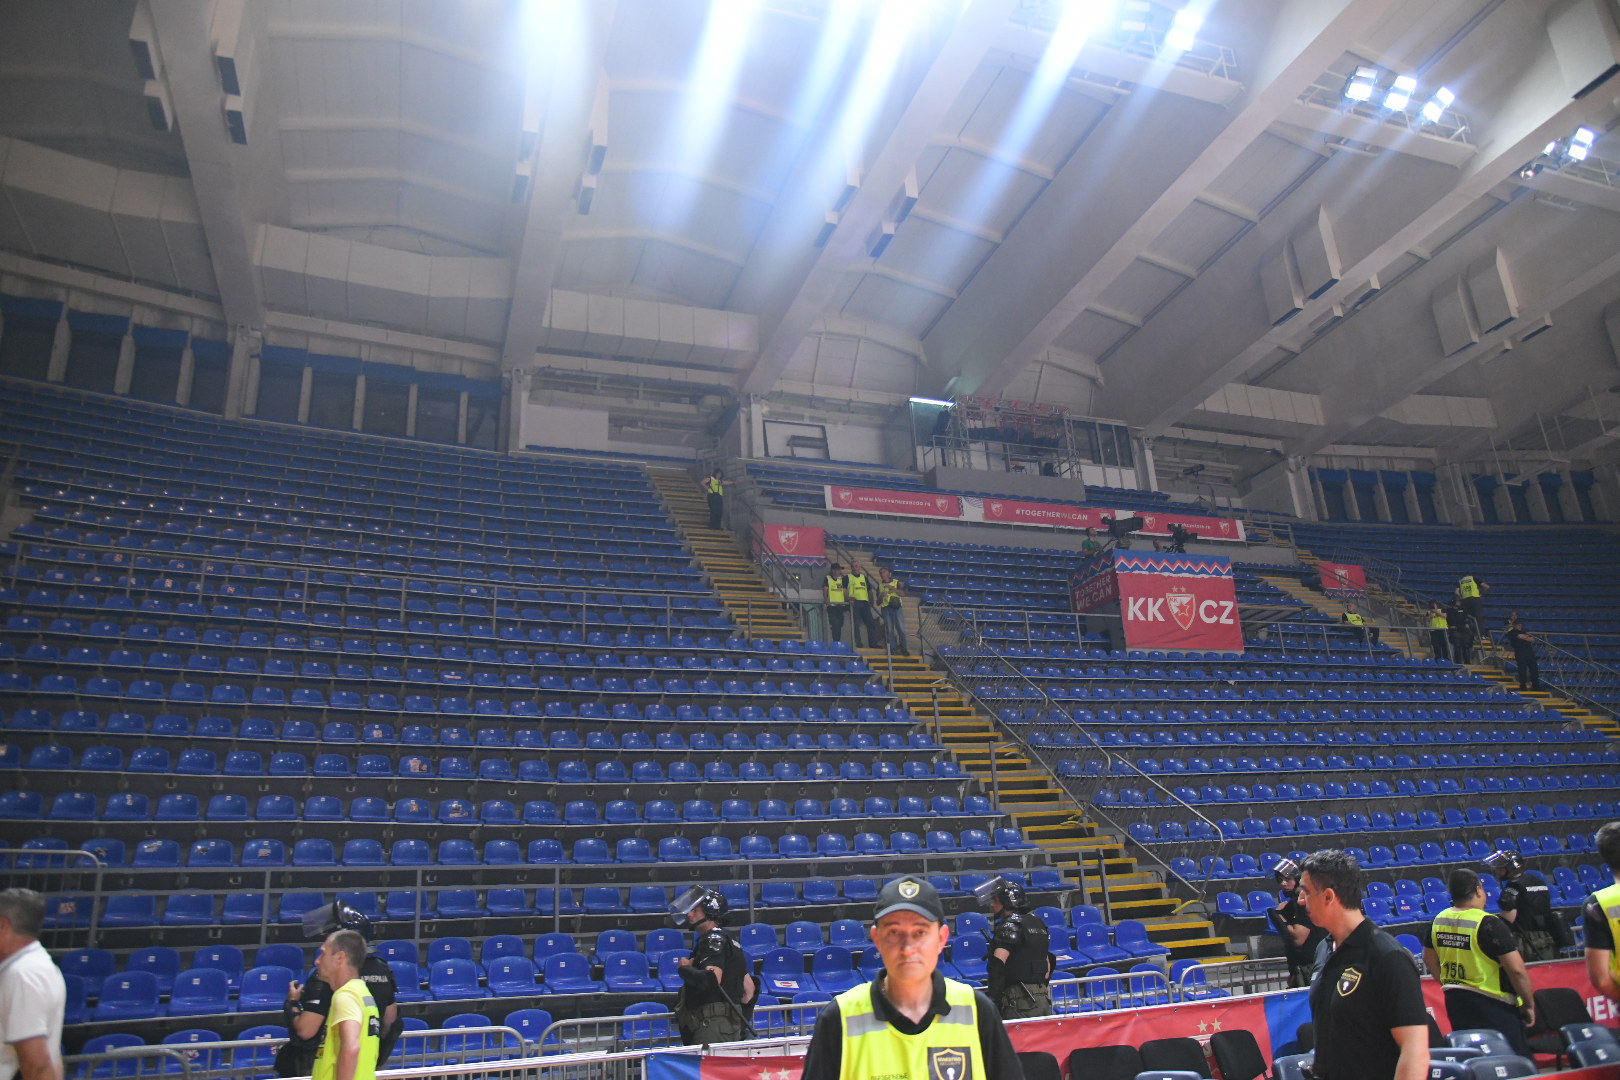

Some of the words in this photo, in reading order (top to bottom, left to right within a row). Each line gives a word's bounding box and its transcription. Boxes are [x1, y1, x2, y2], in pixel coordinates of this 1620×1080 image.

[1075, 574, 1111, 599] TOGETHER
[1076, 596, 1091, 611] WE
[1092, 584, 1112, 602] CAN
[1127, 596, 1165, 622] KK
[1199, 600, 1234, 625] CZ
[1443, 961, 1466, 980] 150
